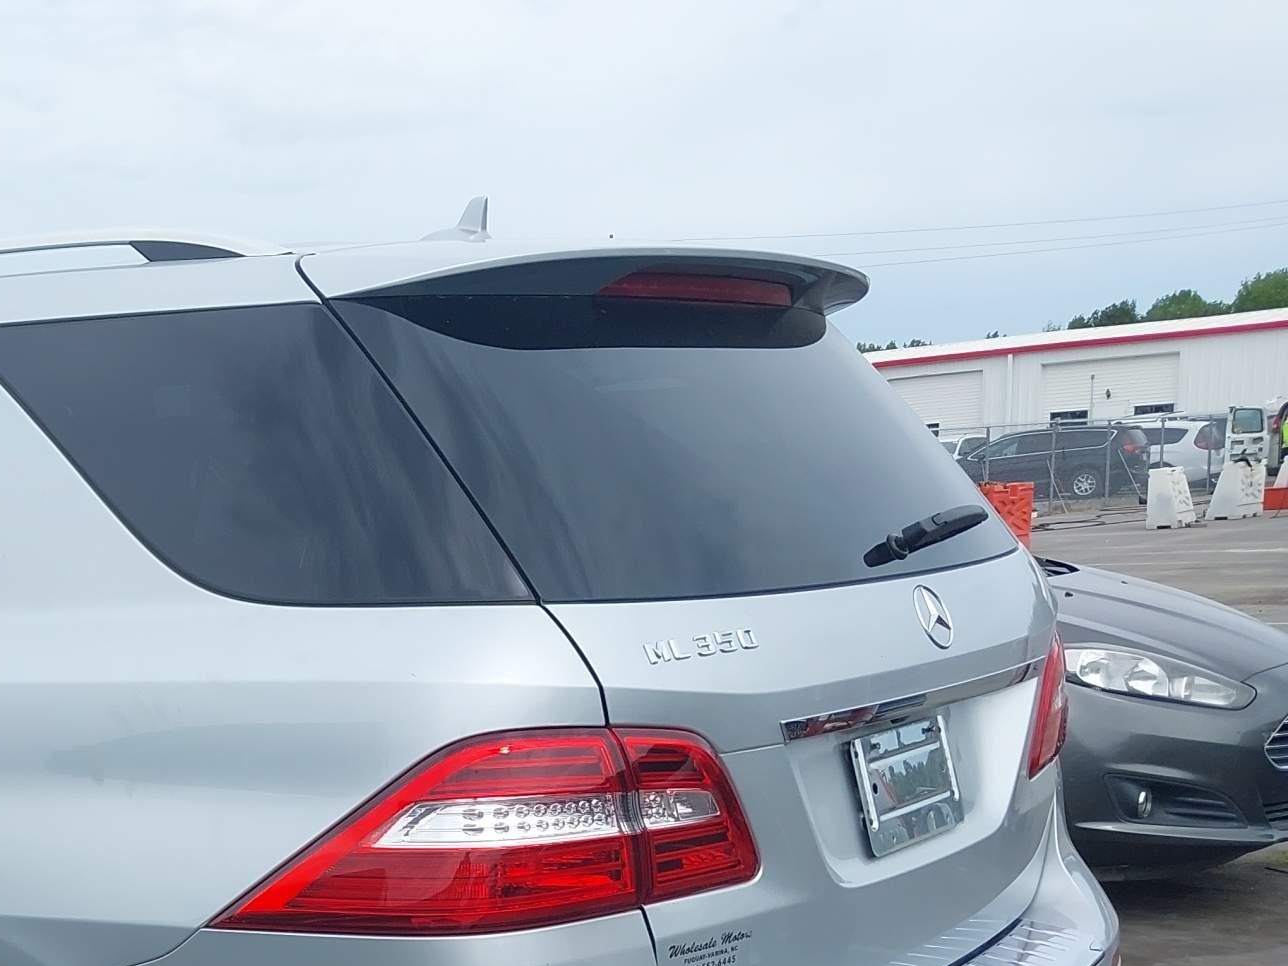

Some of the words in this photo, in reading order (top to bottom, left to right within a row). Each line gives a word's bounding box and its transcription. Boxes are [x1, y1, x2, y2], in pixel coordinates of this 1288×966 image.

[642, 639, 692, 665] ML
[692, 628, 760, 657] 350
[667, 937, 717, 959] Wholesale
